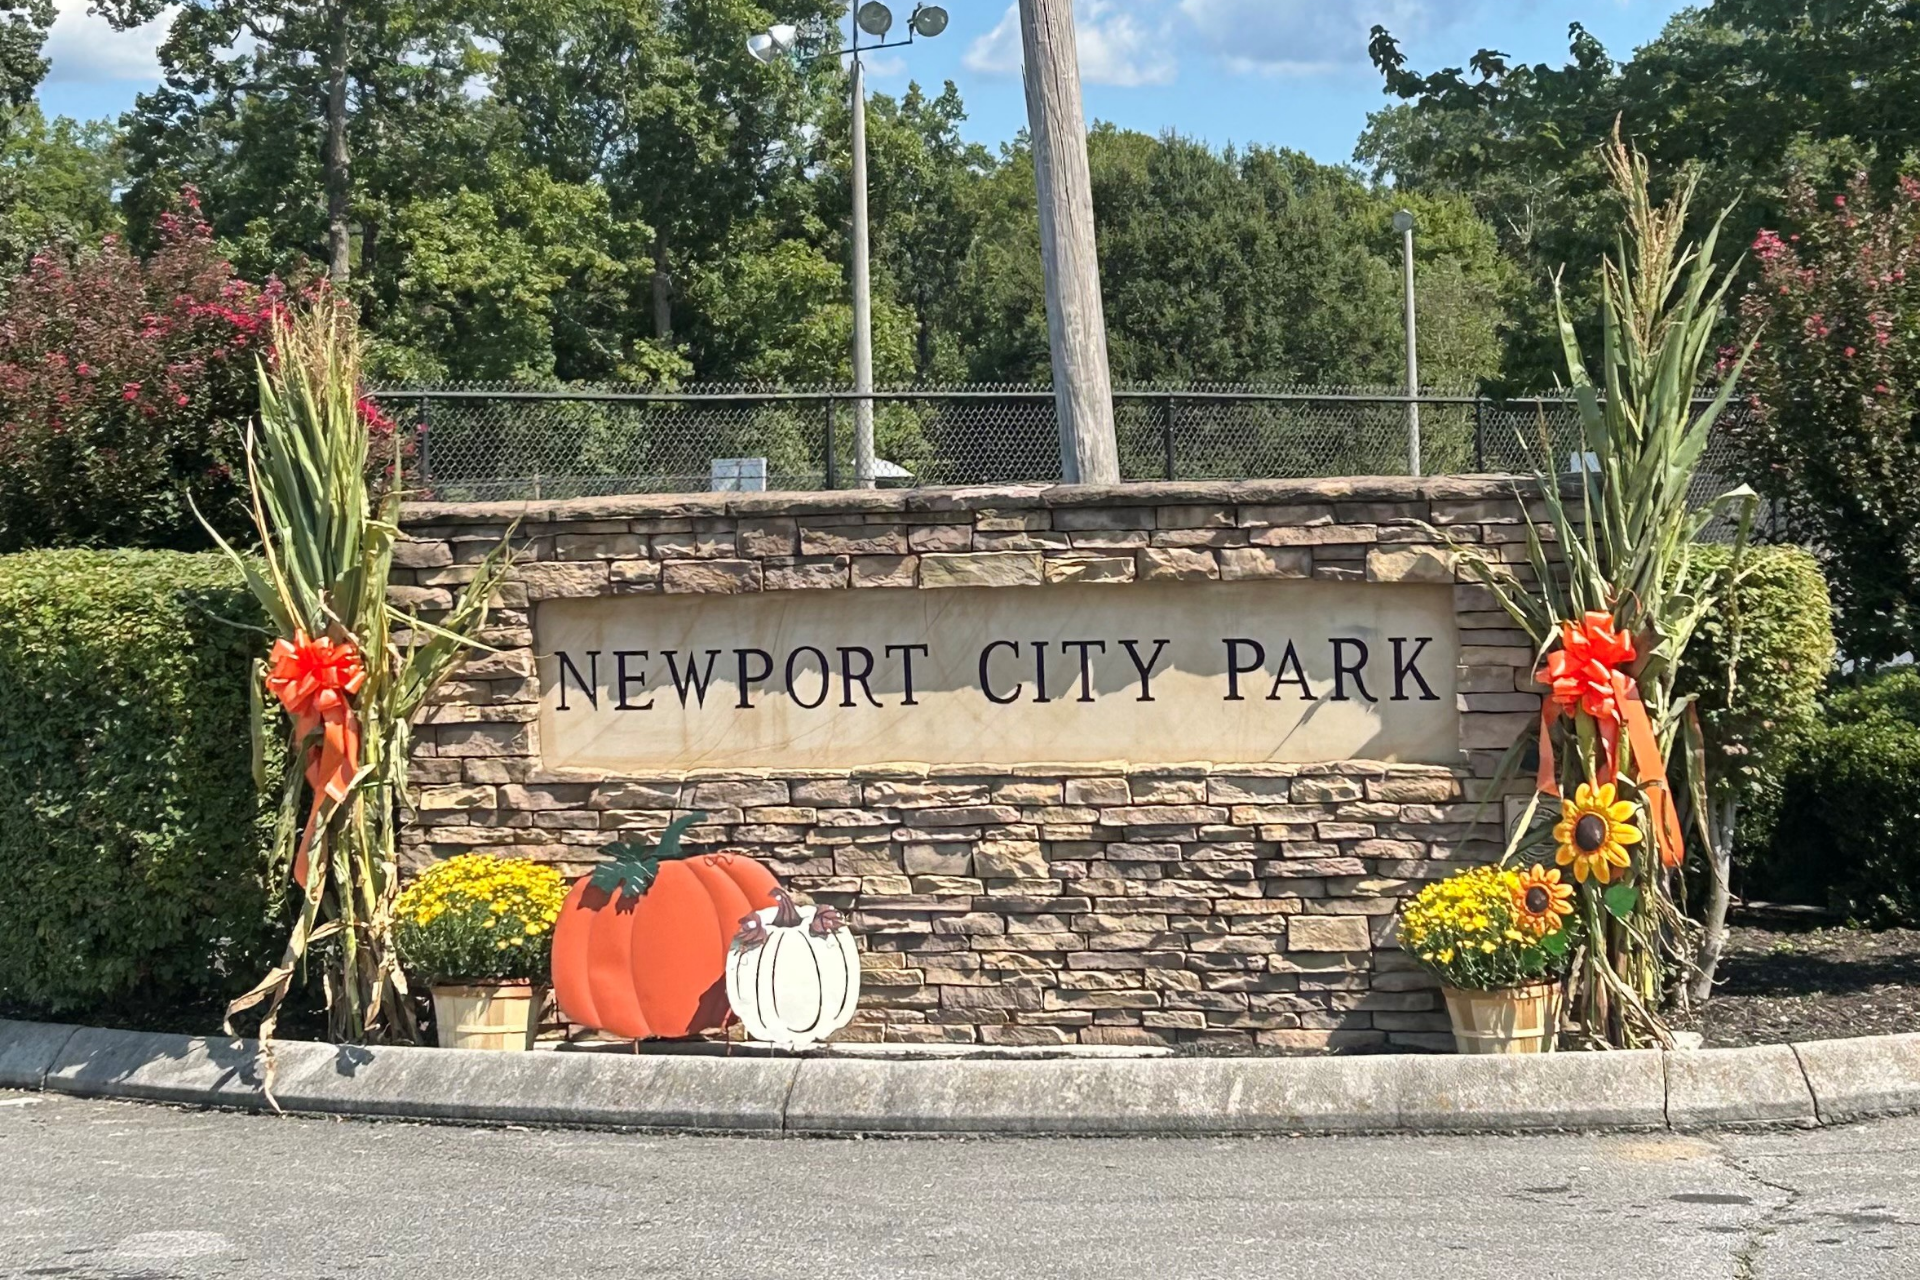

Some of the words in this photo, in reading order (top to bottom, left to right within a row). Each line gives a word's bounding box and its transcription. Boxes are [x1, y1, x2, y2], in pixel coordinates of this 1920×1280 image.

[554, 643, 929, 711] NEWPORT
[979, 640, 1171, 704] CITY
[1222, 637, 1441, 703] PARK
